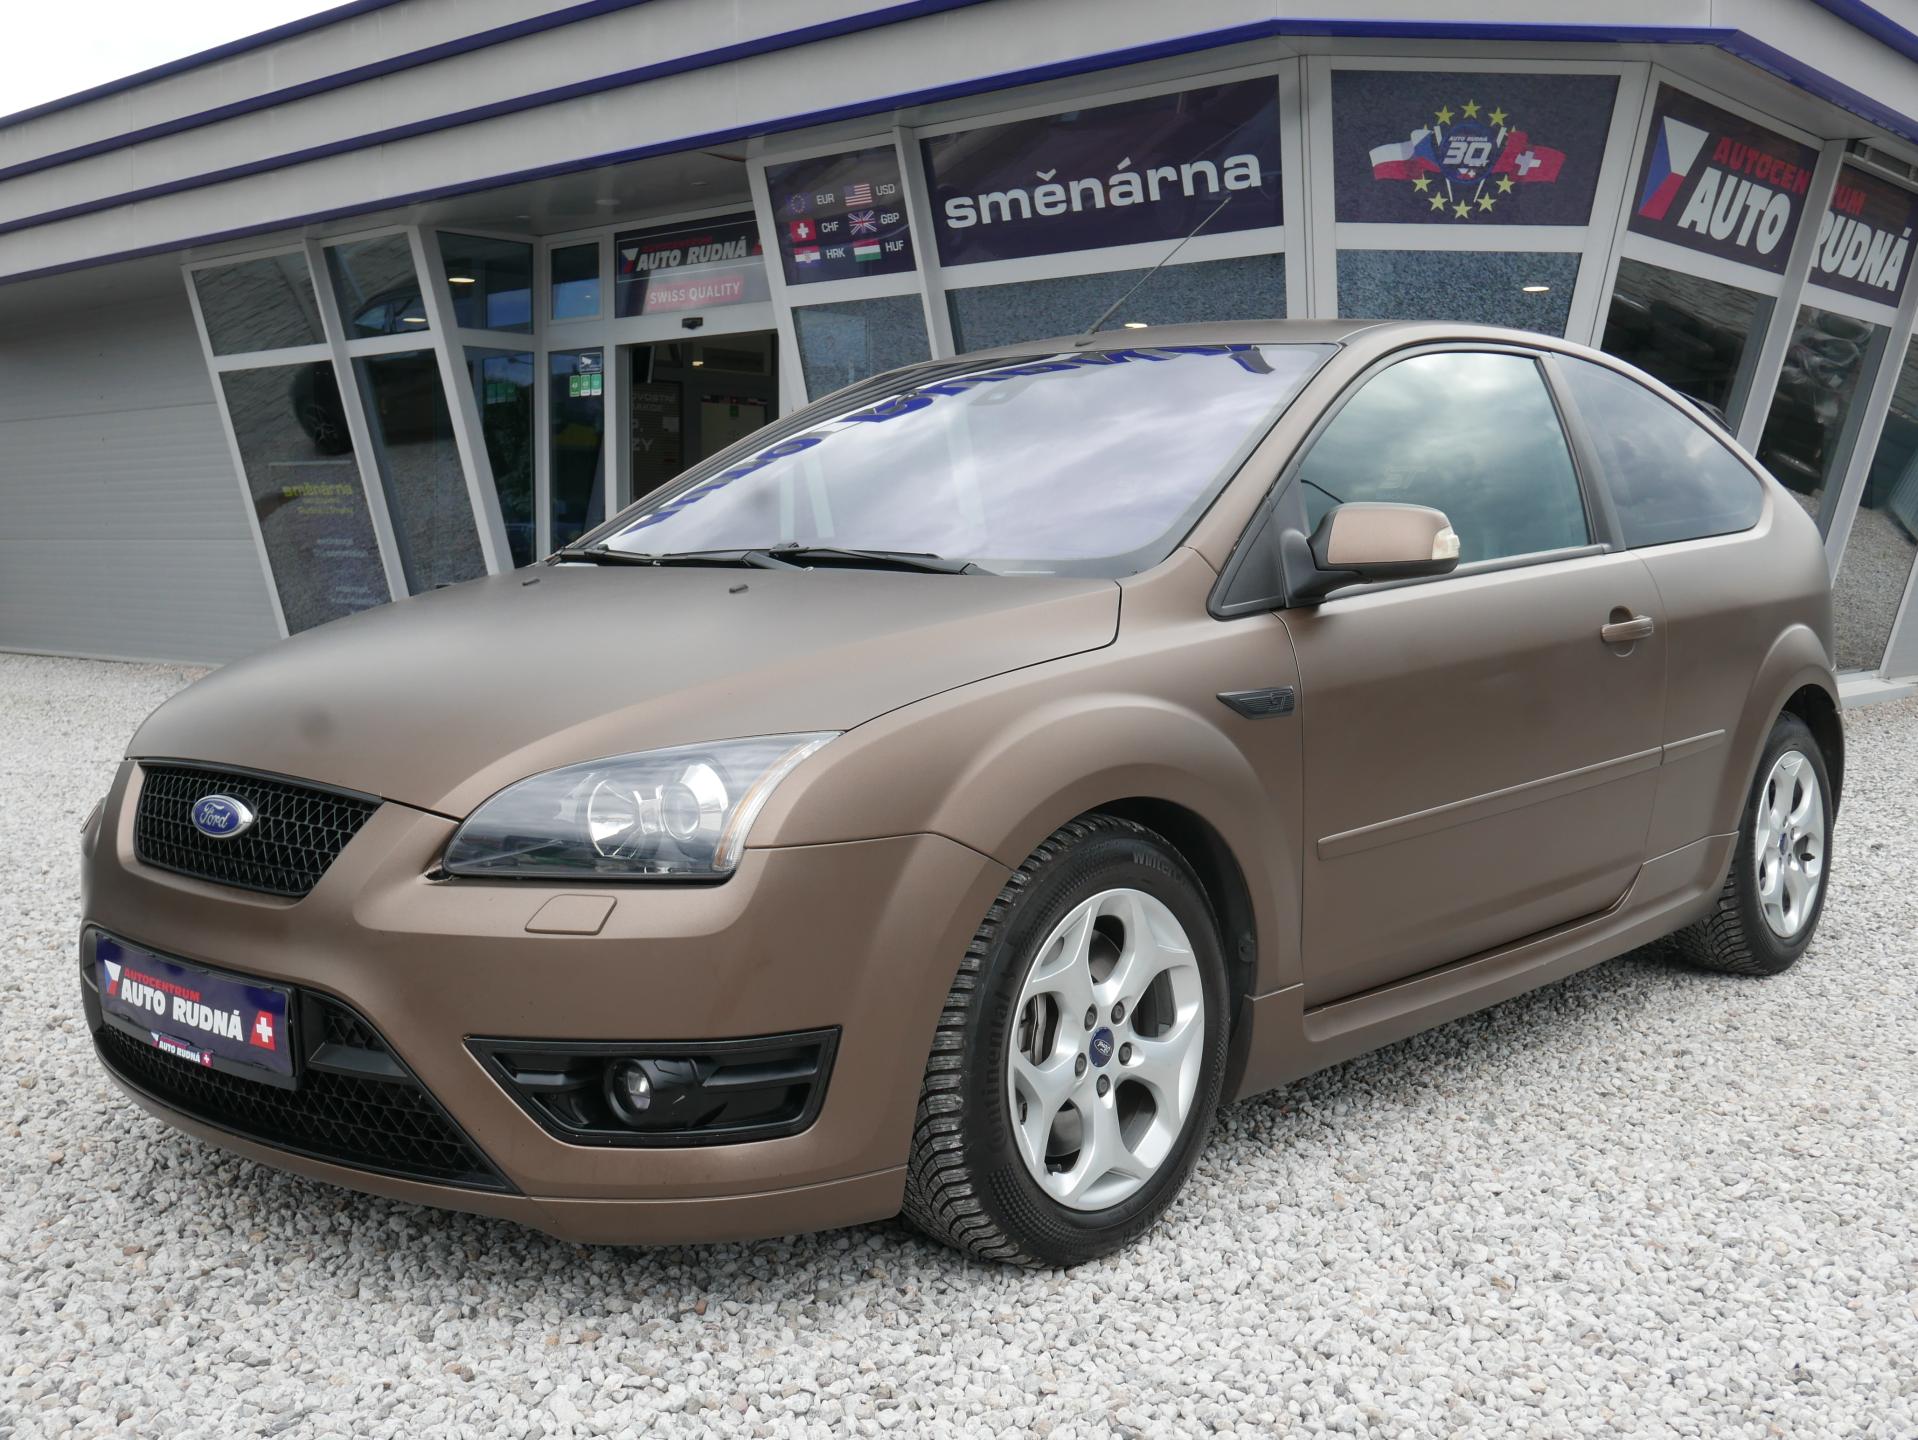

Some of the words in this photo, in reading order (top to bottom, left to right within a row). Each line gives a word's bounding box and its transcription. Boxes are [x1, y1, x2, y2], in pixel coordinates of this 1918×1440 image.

[1443, 141, 1492, 167] 30
[1713, 137, 1813, 194] AUTOCEN
[816, 193, 835, 205] EUR
[876, 183, 896, 195] USD
[945, 156, 1262, 229] směnárna
[821, 221, 839, 232] CHF
[880, 212, 900, 224] GBP
[1677, 166, 1791, 255] AUTO
[636, 249, 682, 271] AUTO
[686, 236, 747, 265] RUDNÁ
[826, 248, 846, 259] HRK
[885, 240, 905, 252] HUF
[651, 289, 686, 304] SWISS
[688, 283, 740, 301] QUALITY
[200, 803, 230, 829] Ford
[124, 967, 202, 1002] AUTOCENTRUM
[121, 978, 166, 1016] AUTO
[172, 995, 244, 1042] RUDNÁ
[158, 1040, 176, 1054] AUTO
[176, 1047, 201, 1063] RUDNÁ
